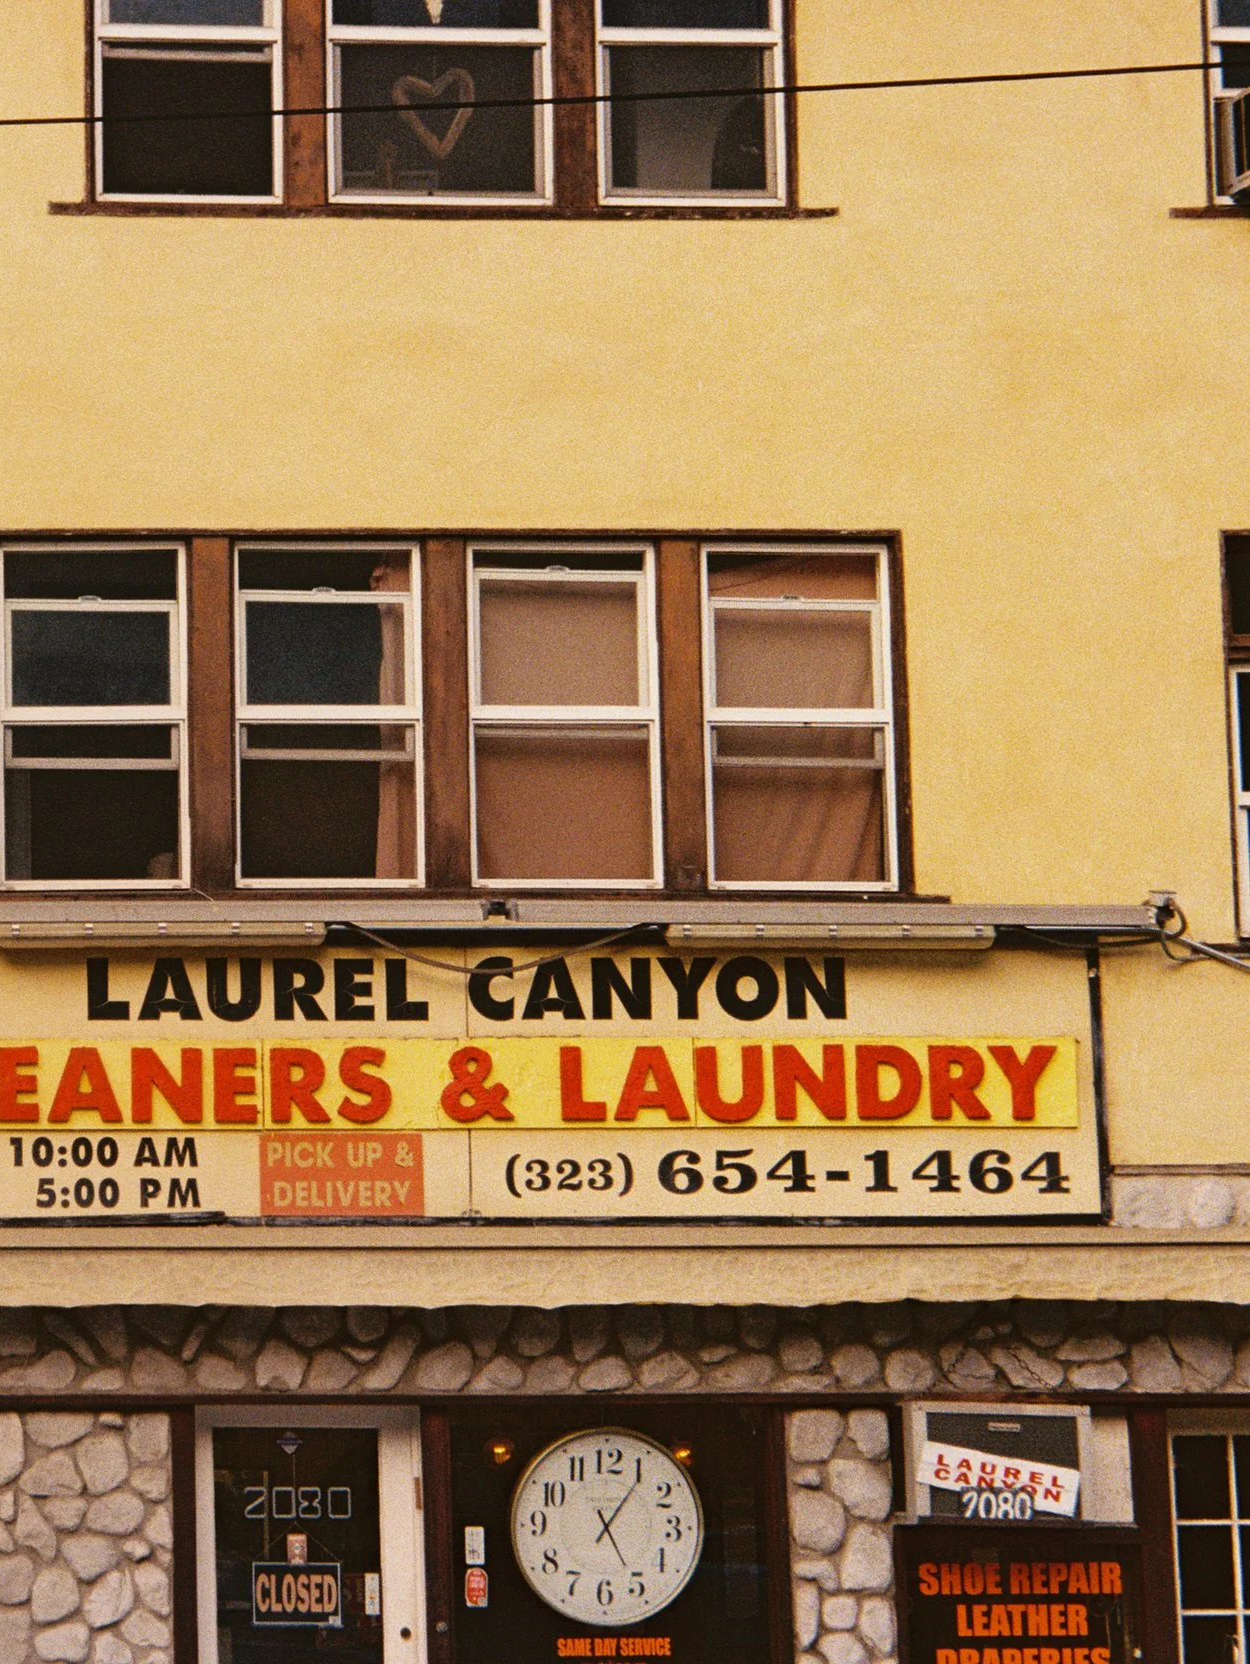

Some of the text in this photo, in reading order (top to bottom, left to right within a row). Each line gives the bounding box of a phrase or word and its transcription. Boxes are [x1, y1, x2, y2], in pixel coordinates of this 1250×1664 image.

[86, 956, 848, 1023] LAUREL CANYON
[441, 1045, 515, 1122] &
[559, 1044, 1058, 1123] LAUNDRY
[10, 1137, 120, 1168] 10:00
[133, 1137, 199, 1168] AM
[267, 1141, 414, 1168] PICK UP &
[505, 1149, 1071, 1198] (323) 654-1464
[36, 1177, 121, 1208] 5:00
[140, 1178, 201, 1208] PM
[273, 1180, 411, 1207] DELIVERY
[934, 1468, 1062, 1502] CANYON
[936, 1453, 1065, 1489] LAUREL
[244, 1487, 351, 1519] 2080
[543, 1480, 566, 1507] 10
[656, 1482, 672, 1508] 2
[530, 1510, 547, 1536] 9
[665, 1516, 682, 1541] 3
[542, 1548, 559, 1574] 8
[566, 1570, 582, 1596] 7
[597, 1579, 614, 1606] 6
[628, 1572, 645, 1597] 5
[918, 1561, 1123, 1595] SHOE REPAIR
[256, 1573, 338, 1613] CLOSED
[956, 1604, 1089, 1637] LEATHER
[557, 1637, 671, 1656] SAME DAY SERVICE
